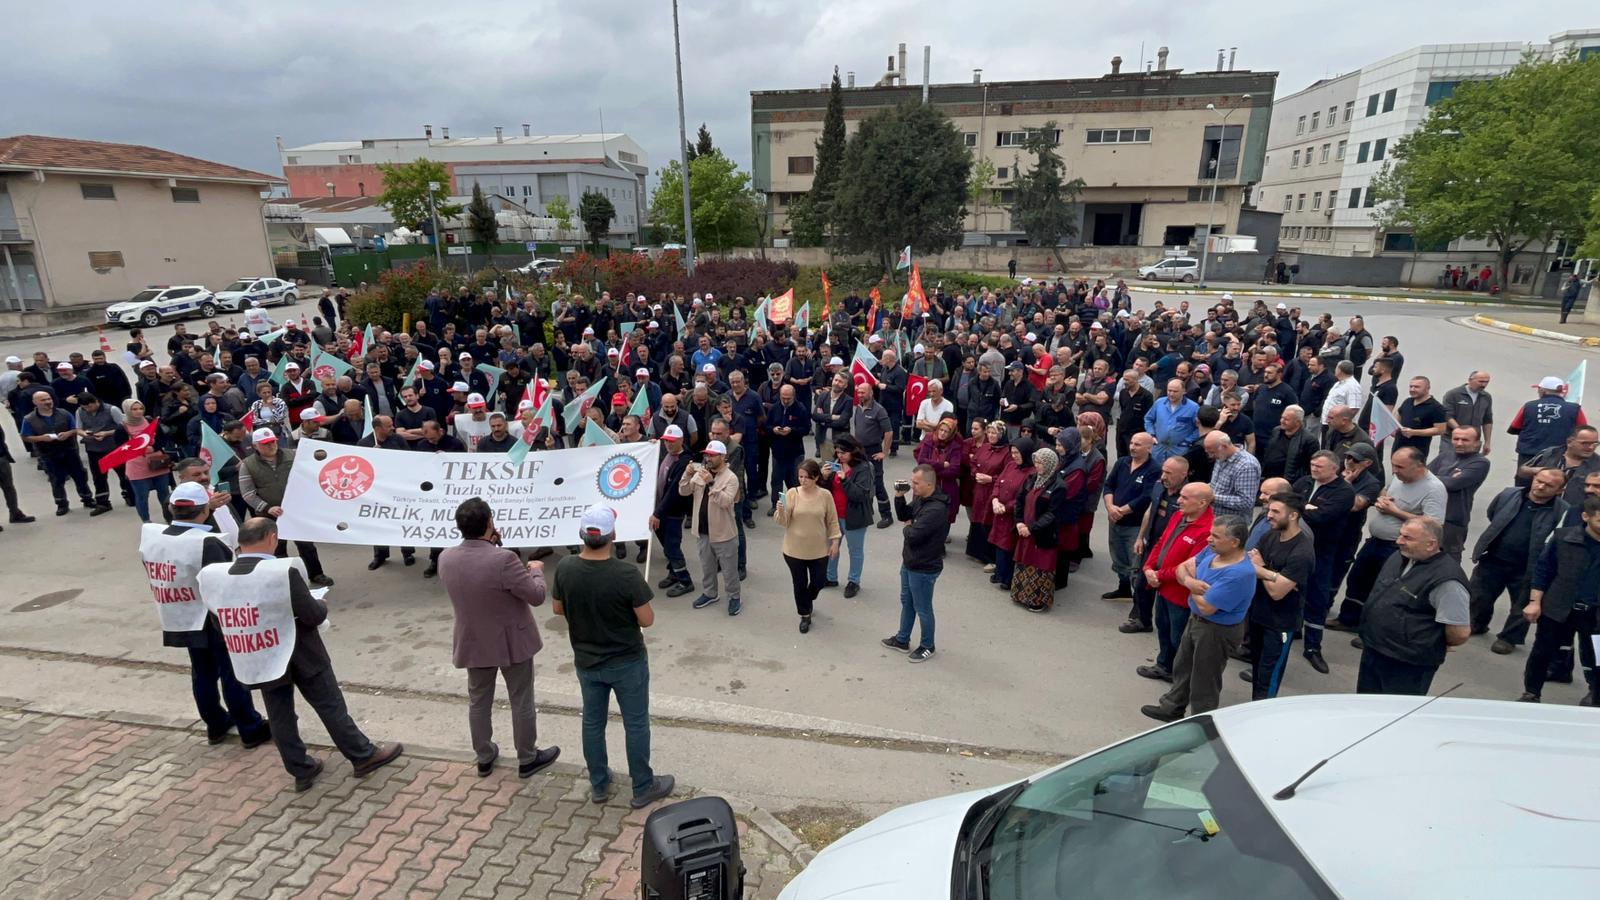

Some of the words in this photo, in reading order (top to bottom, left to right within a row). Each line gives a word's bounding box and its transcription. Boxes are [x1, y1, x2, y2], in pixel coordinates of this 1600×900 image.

[443, 483, 482, 496] Tuzla
[487, 482, 534, 497] Şubesi
[358, 502, 424, 522] BİRLİK,
[431, 506, 533, 523] MÜELE,
[401, 525, 464, 542] YAŞAS
[501, 525, 557, 540] MAYIS!
[217, 602, 259, 628] TEKSİF
[224, 628, 280, 653] NDİKASI
